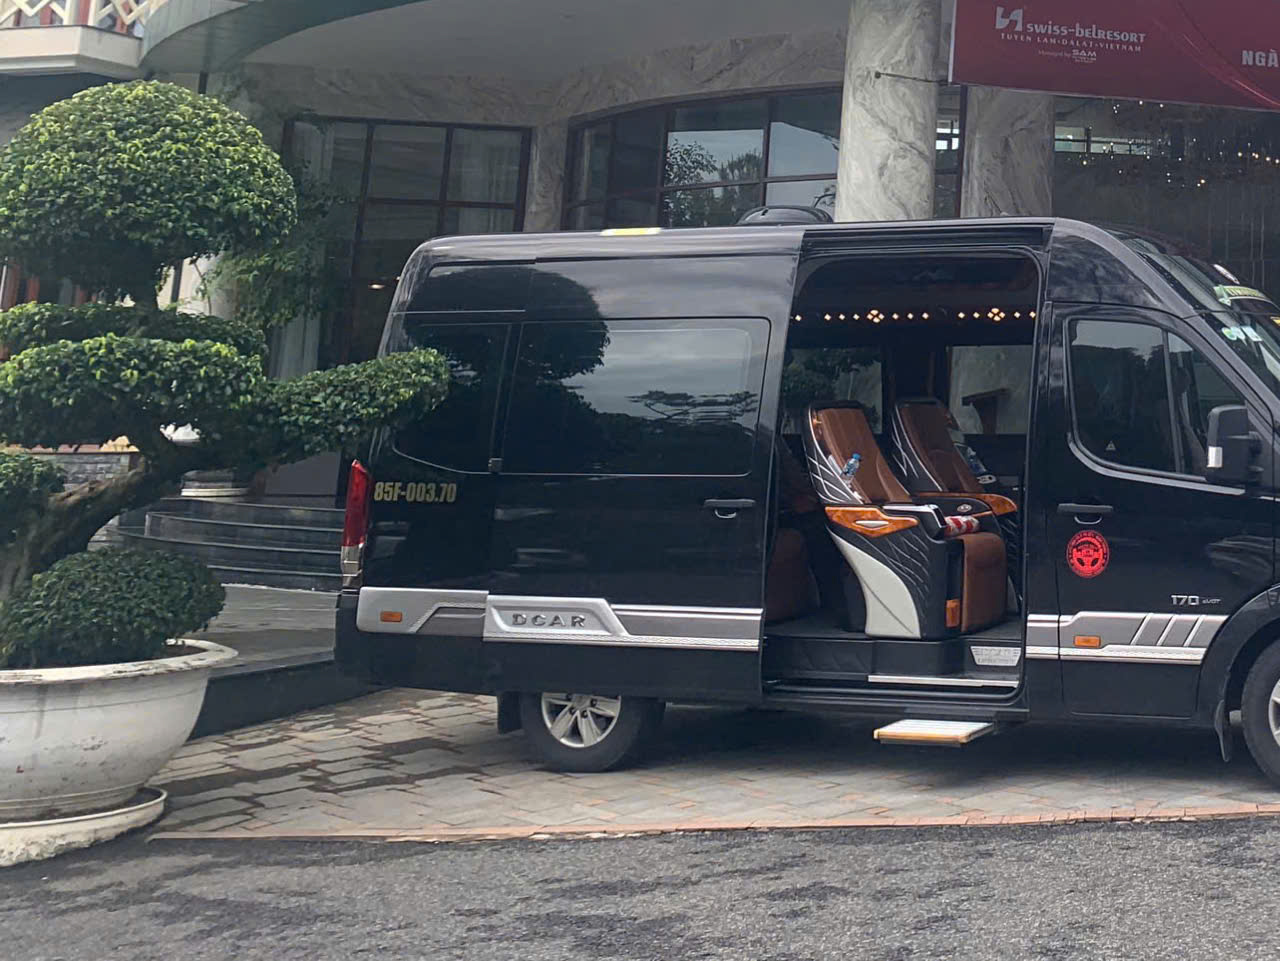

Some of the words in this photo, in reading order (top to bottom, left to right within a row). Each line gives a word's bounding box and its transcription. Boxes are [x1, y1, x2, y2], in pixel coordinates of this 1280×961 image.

[1001, 33, 1032, 43] TUYEN
[374, 482, 457, 502] 85F-003.70
[1171, 594, 1200, 606] 170
[511, 613, 586, 628] DCAR
